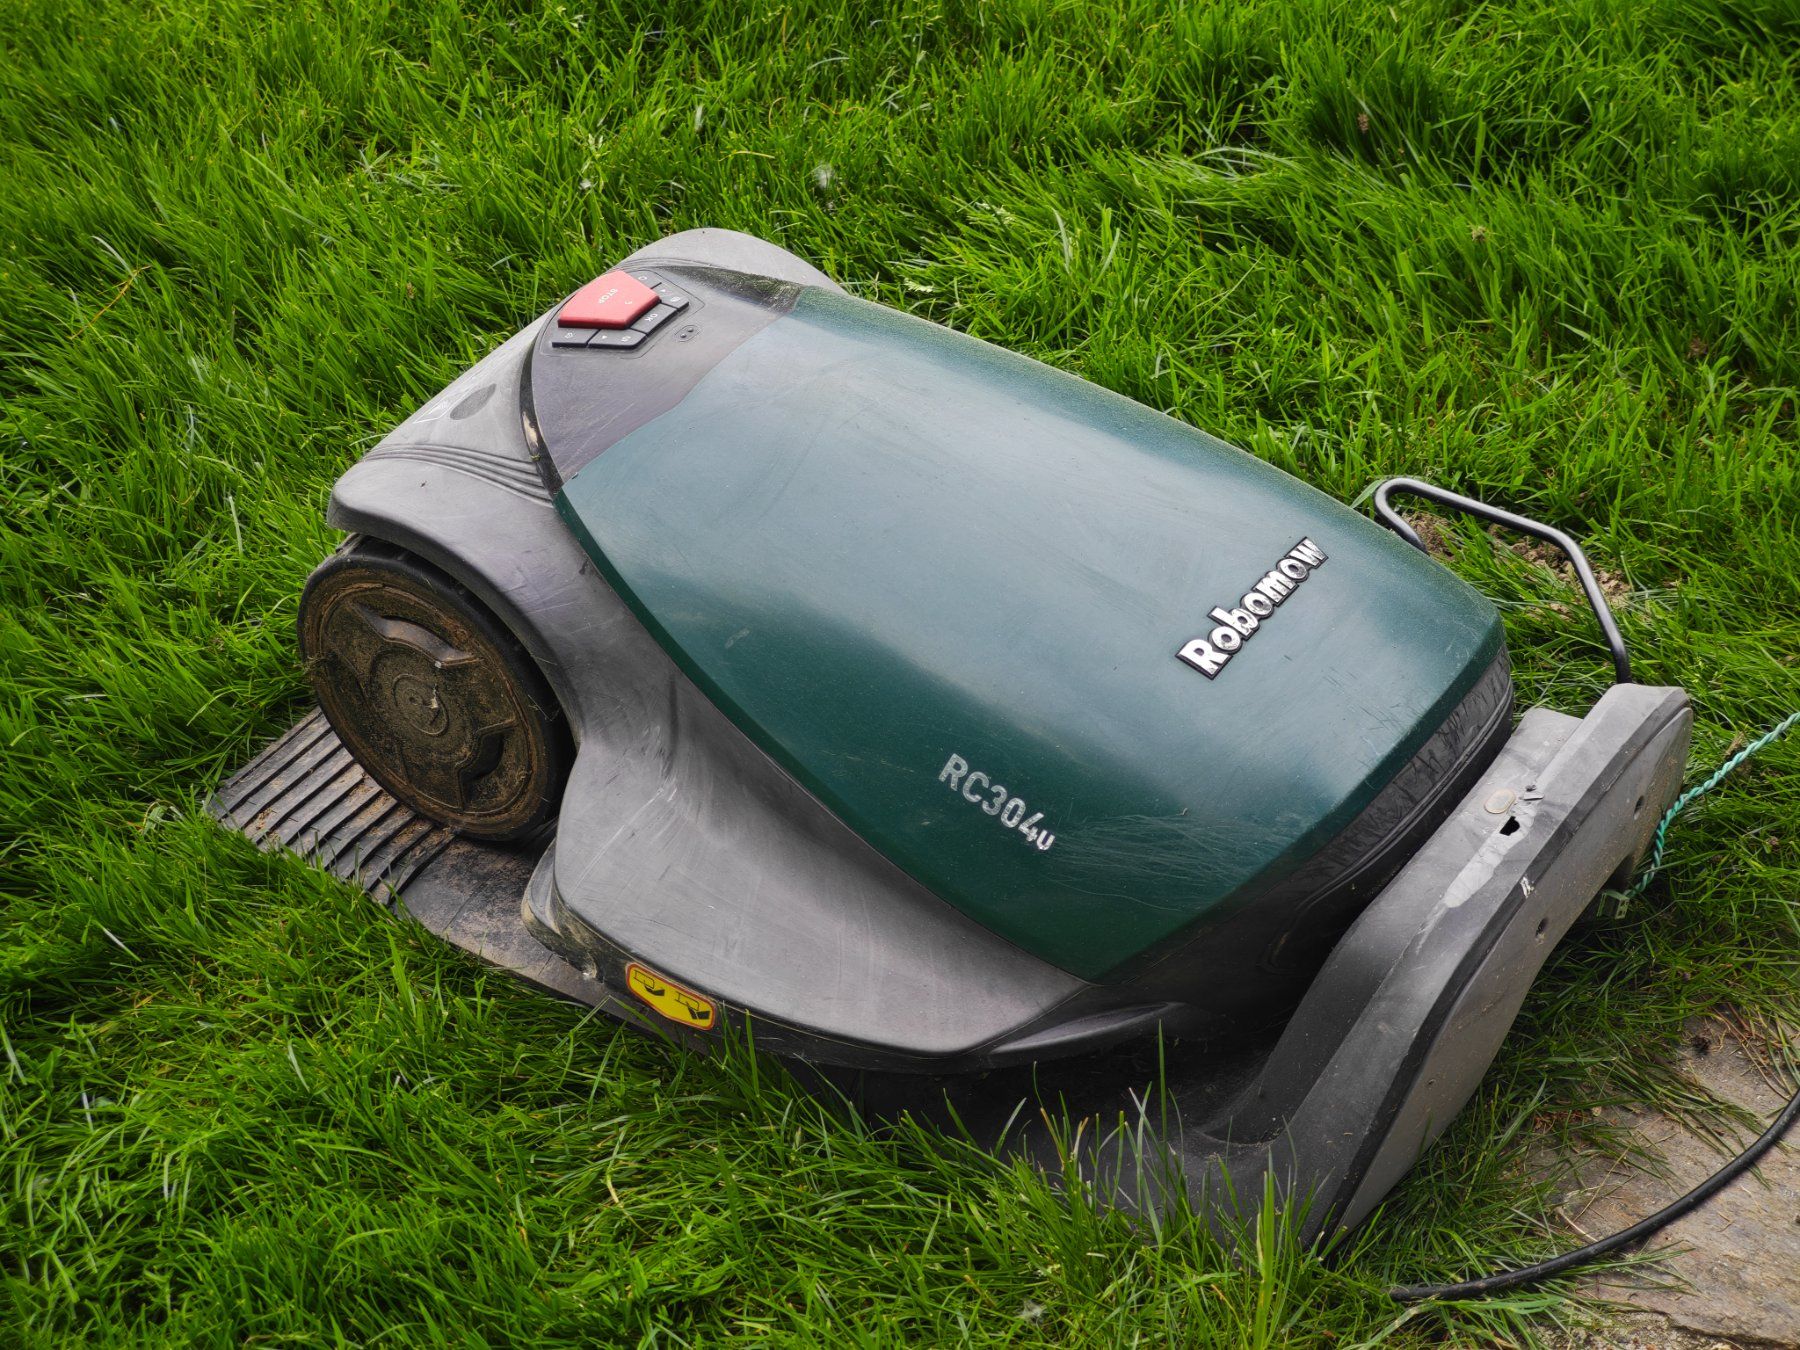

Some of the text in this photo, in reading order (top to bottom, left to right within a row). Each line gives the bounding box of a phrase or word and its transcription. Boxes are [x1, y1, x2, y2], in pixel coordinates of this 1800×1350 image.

[599, 288, 618, 304] STOP
[644, 313, 658, 322] OK
[1175, 536, 1329, 680] Robomow
[938, 753, 1056, 851] RC304u
